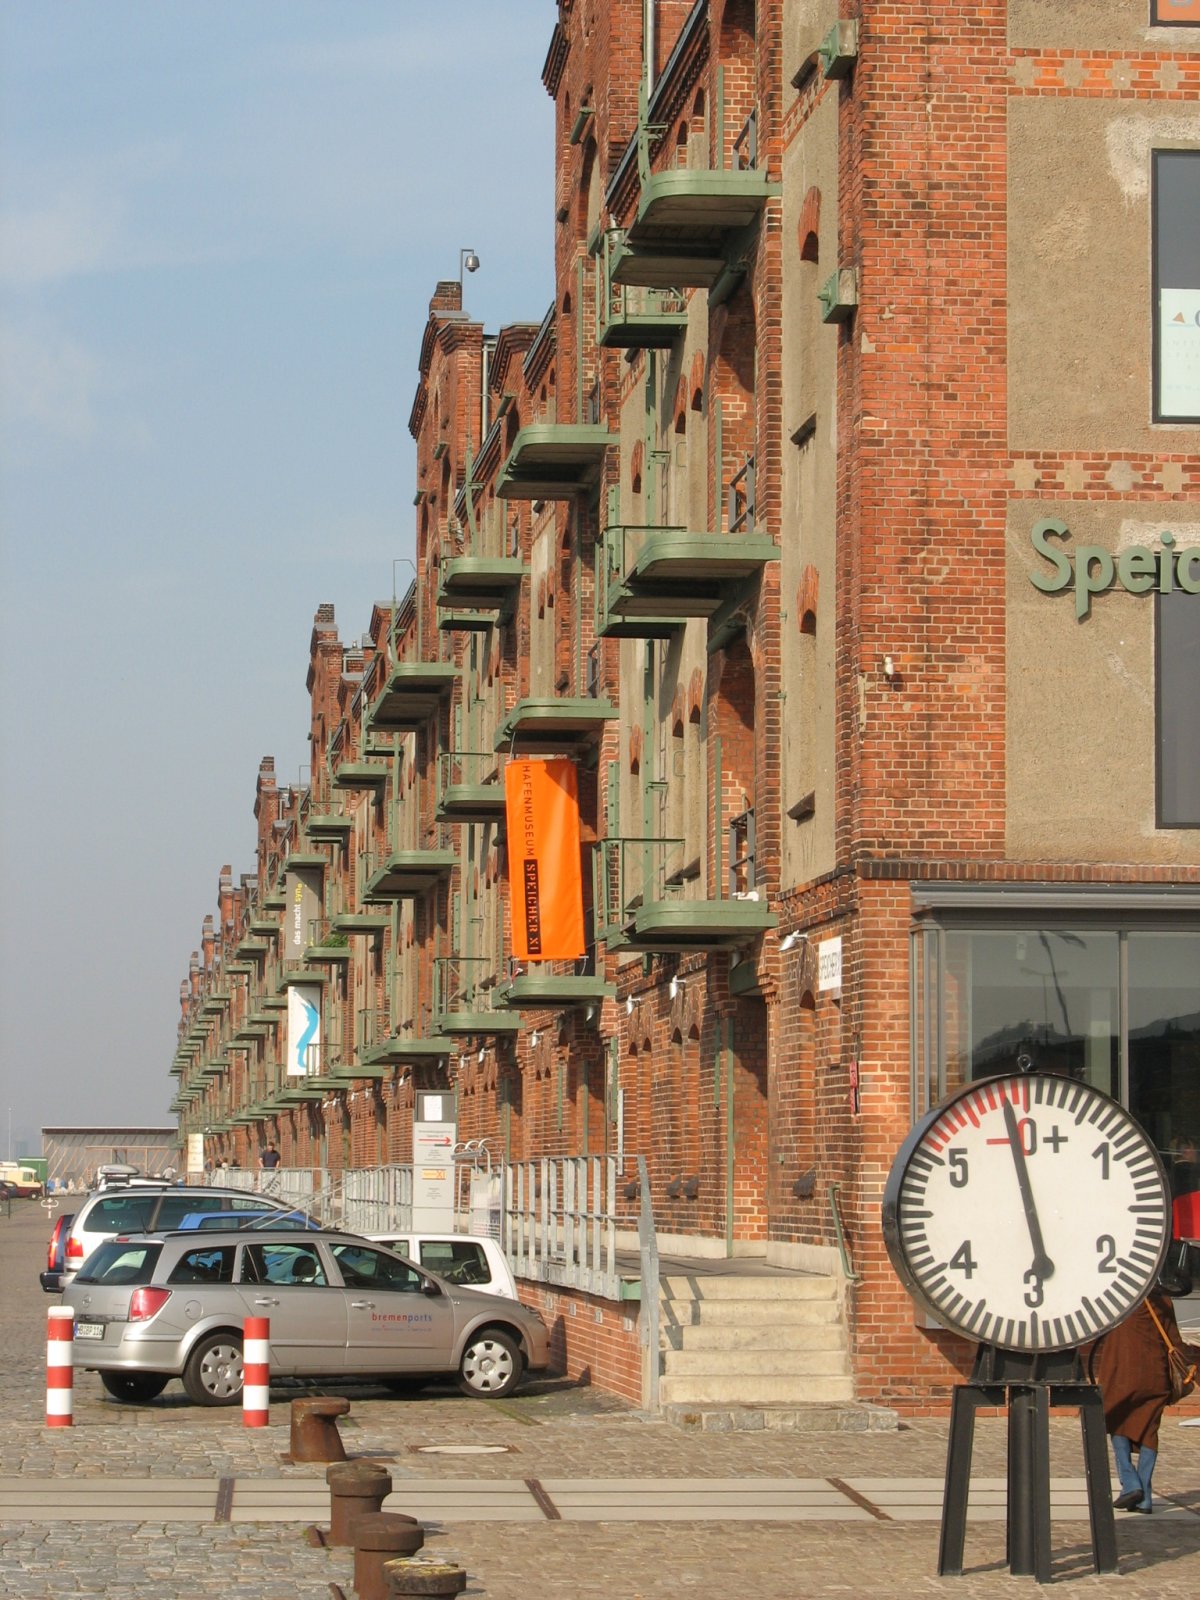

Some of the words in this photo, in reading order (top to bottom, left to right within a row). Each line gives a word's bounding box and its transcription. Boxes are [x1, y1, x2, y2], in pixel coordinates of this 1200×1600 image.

[522, 765, 535, 856] HAFENMUSEUM
[293, 904, 301, 929] macht
[526, 864, 538, 932] SPEICHER
[293, 930, 301, 945] das
[529, 937, 539, 950] XI
[949, 1148, 969, 1188] 5
[1092, 1142, 1109, 1180] 1
[950, 1240, 977, 1279] 4
[1096, 1234, 1117, 1273] 2
[1024, 1268, 1044, 1308] 3
[372, 1312, 432, 1323] bremenports
